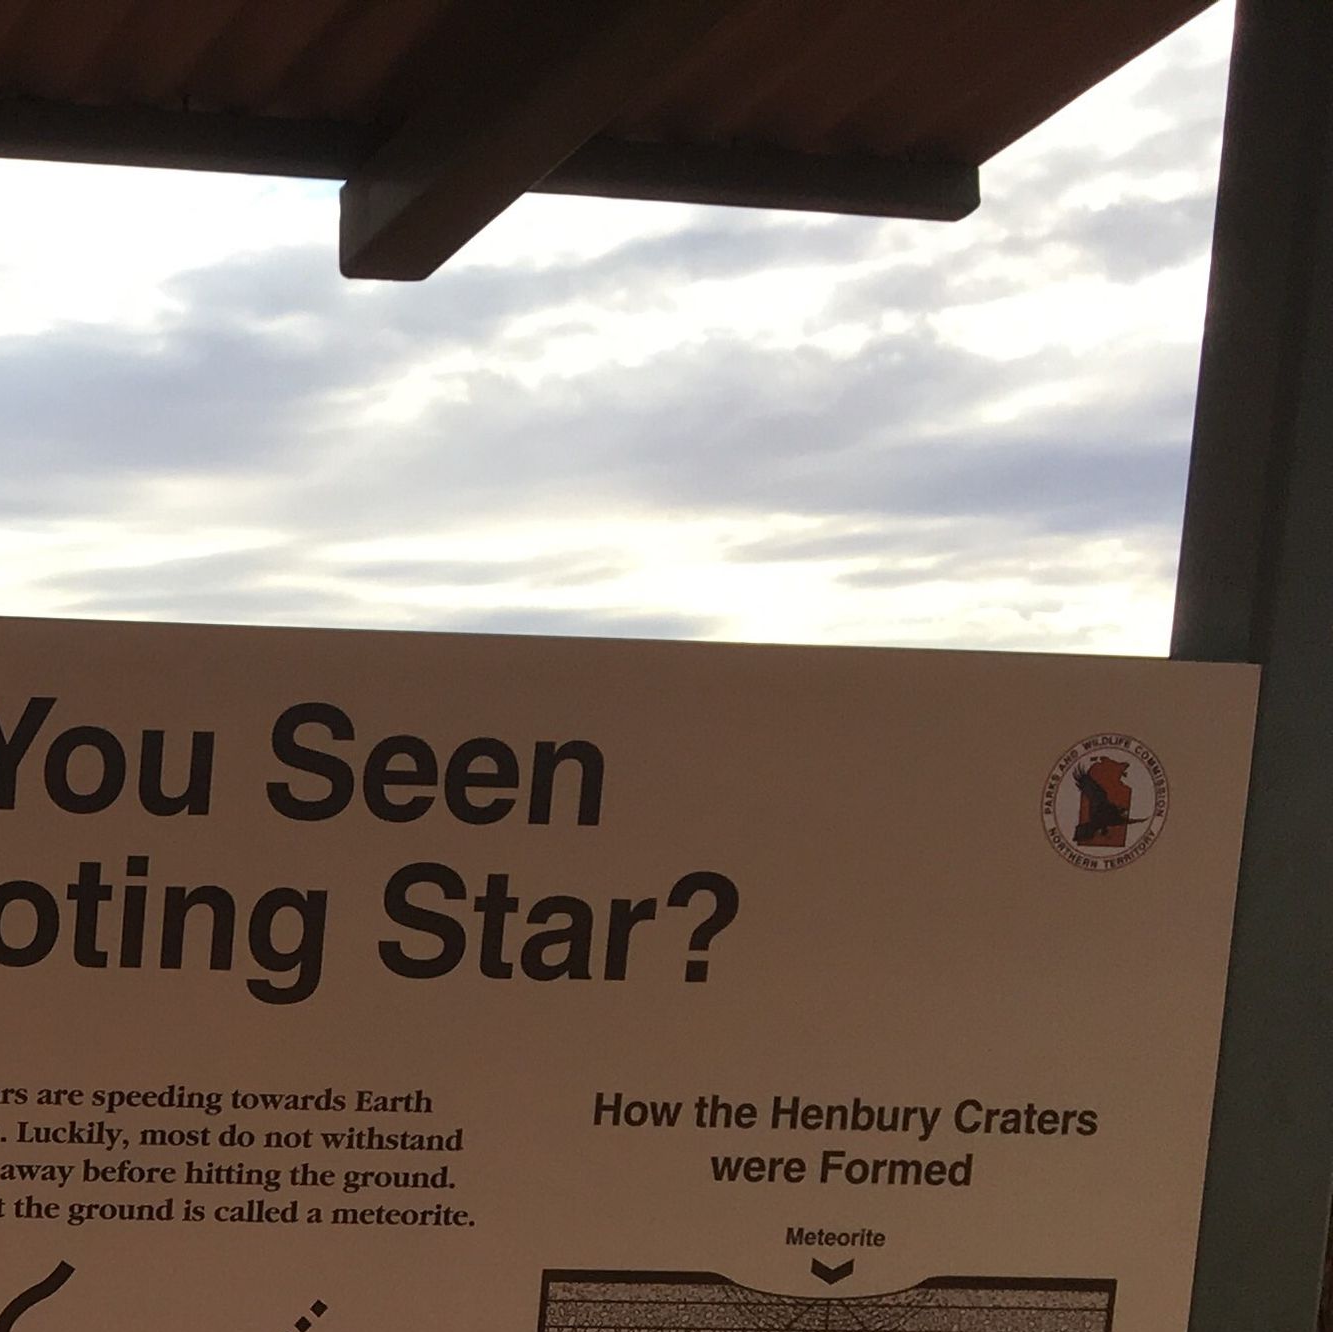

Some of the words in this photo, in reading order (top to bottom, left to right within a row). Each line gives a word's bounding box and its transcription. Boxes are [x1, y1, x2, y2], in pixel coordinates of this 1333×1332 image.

[266, 702, 605, 826] Seen
[378, 861, 740, 983] Star?
[36, 1088, 84, 1106] are
[91, 1084, 223, 1116] speeding
[231, 1087, 346, 1111] towards
[355, 1089, 432, 1113] Earth
[593, 1092, 683, 1127] How
[694, 1094, 758, 1129] the
[771, 1095, 942, 1141] Henbury
[954, 1099, 1098, 1136] Craters
[710, 1156, 807, 1184] were
[819, 1150, 973, 1187] Formed
[785, 1227, 886, 1247] Meteorite
